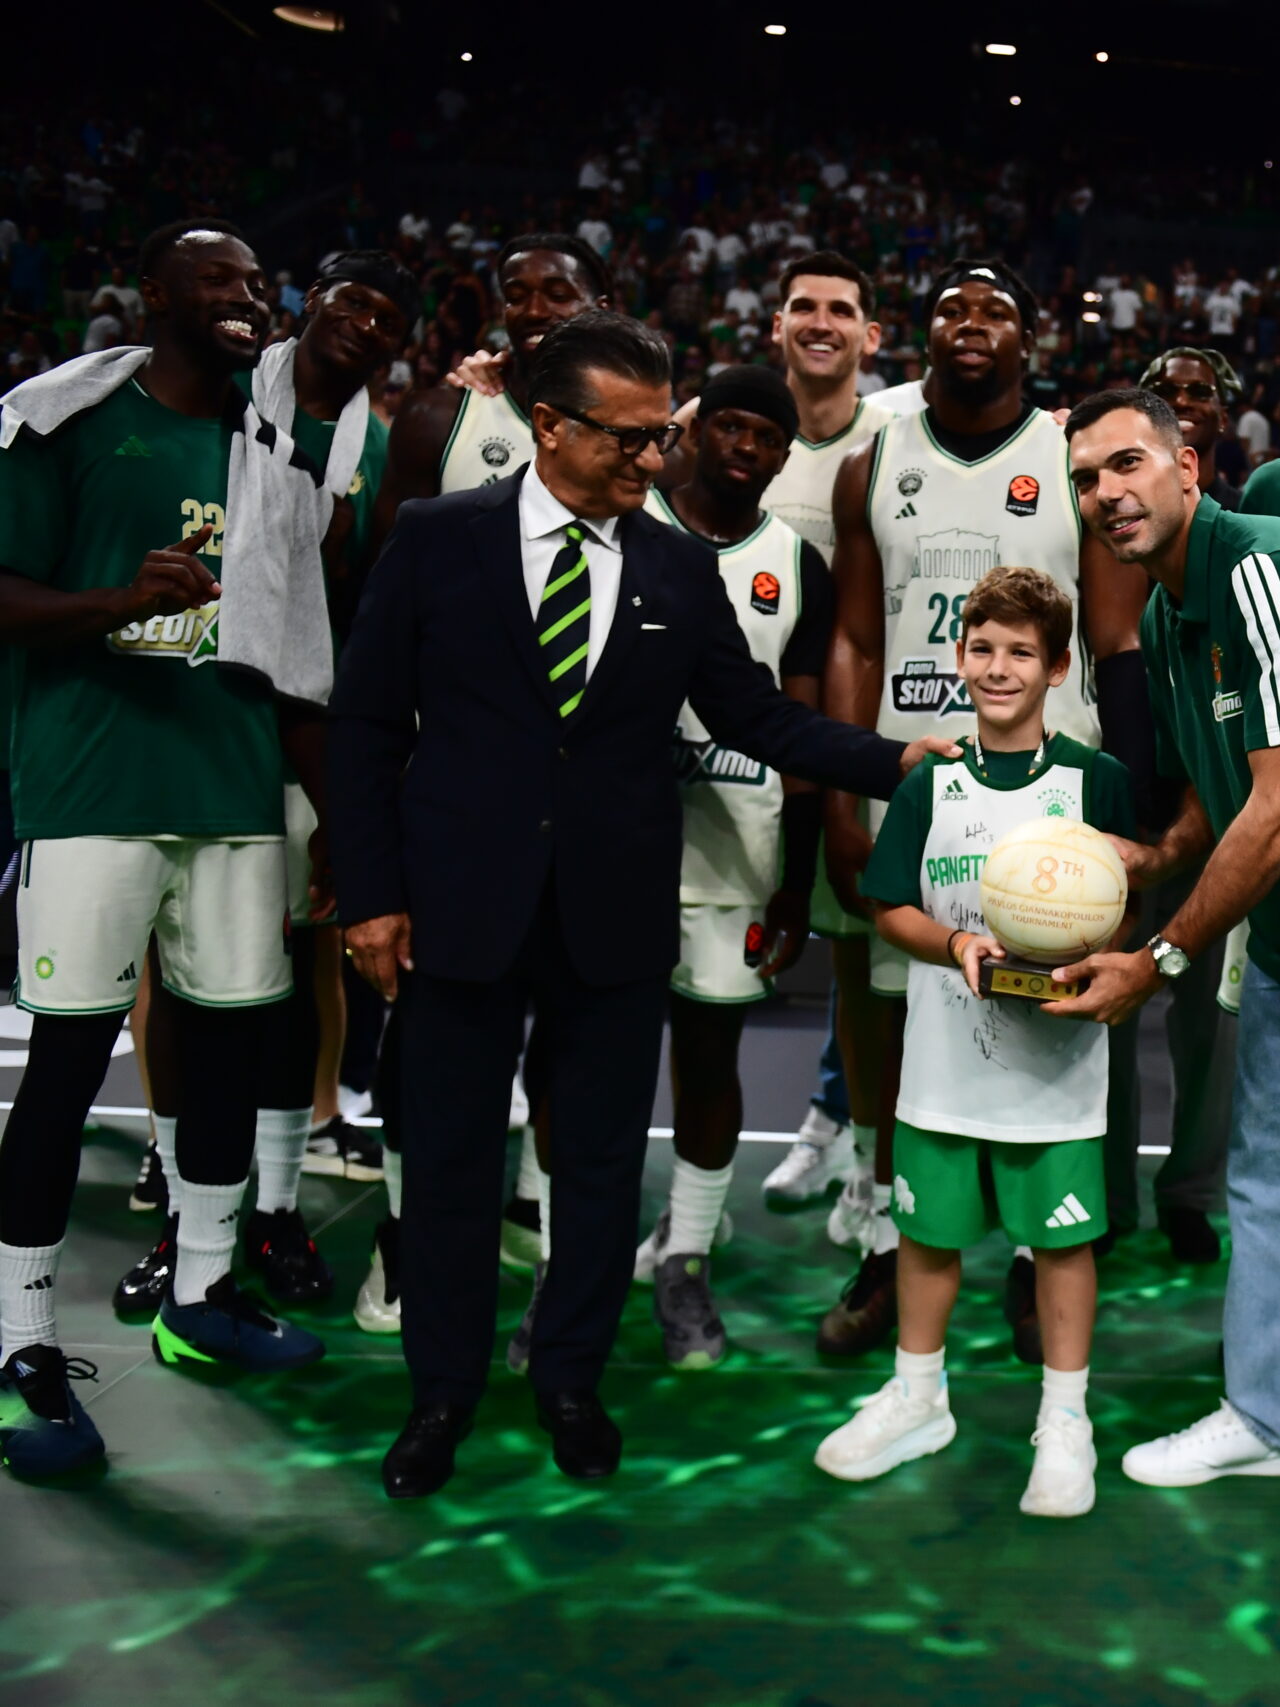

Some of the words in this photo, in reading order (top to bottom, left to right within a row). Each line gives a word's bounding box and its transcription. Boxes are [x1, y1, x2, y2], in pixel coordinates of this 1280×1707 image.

[181, 498, 226, 556] 22
[928, 592, 966, 643] 28
[941, 792, 968, 801] adidas
[987, 896, 1018, 911] PAVLOS
[1019, 903, 1105, 922] GIANNAKOPOULOS
[1011, 914, 1074, 930] TOURNAMENT
